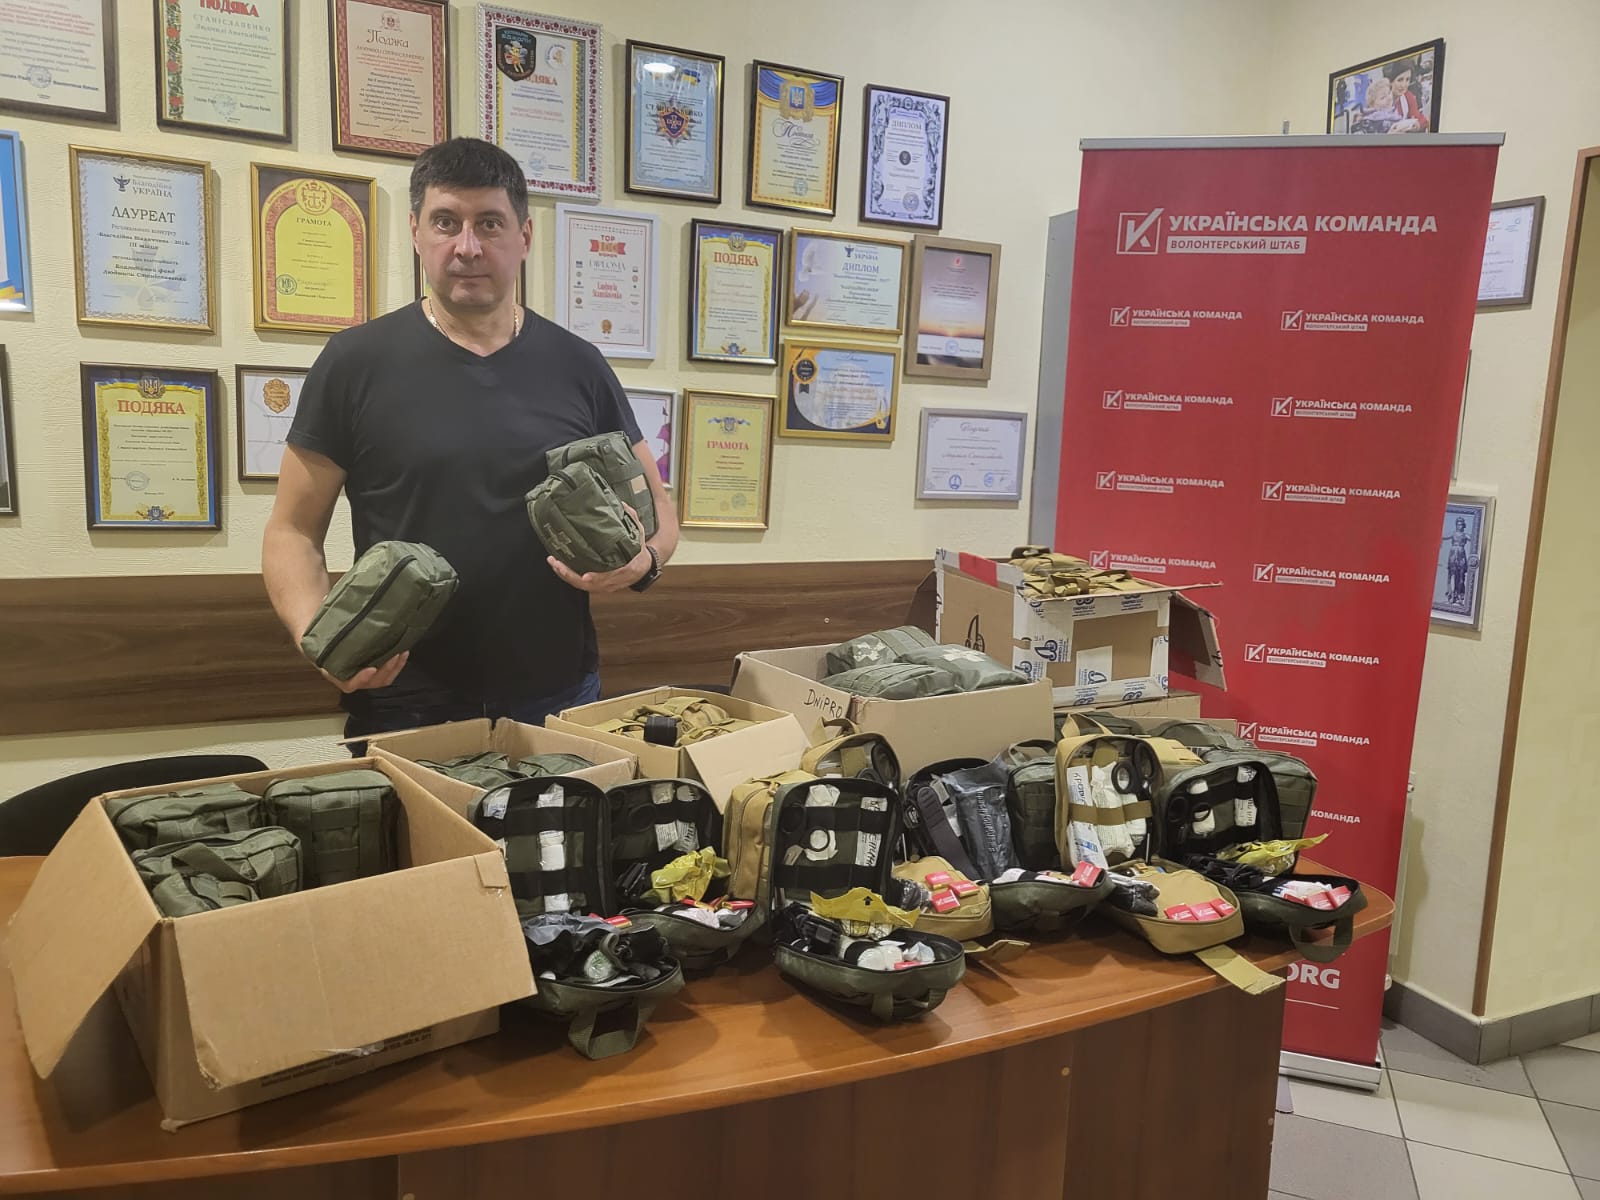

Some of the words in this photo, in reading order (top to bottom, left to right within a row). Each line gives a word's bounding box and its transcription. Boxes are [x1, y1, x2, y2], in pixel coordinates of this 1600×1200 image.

[891, 120, 922, 131] ДИПЛОМ
[132, 187, 173, 198] УКРАЇНА
[111, 206, 176, 224] ЛАУРЕАТ
[296, 217, 332, 227] ГРАМОТА
[1168, 211, 1308, 232] УКРАЇНСЬКА
[1314, 215, 1438, 235] КОМАНДА
[600, 234, 616, 242] TOP
[1170, 239, 1266, 250] ВОЛОНТЕРСЬКИЙ
[1270, 240, 1301, 250] ШТАБ
[714, 252, 759, 266] ПОДЯКА
[842, 262, 880, 274] ДИПЛОМ
[1132, 308, 1190, 318] УКРАЇНСЬКА
[1193, 310, 1242, 320] КОМАНДА
[1306, 312, 1368, 322] УКРАЇНСЬКА
[1371, 314, 1424, 324] КОМАНДА
[1125, 392, 1182, 402] УКРАЇНСЬКА
[1184, 395, 1234, 405] КОМАНДА
[117, 400, 186, 416] ПОДЯКА
[1295, 399, 1358, 410] УКРАЇНСЬКА
[1360, 402, 1412, 412] КОМАНДА
[707, 440, 749, 451] ГРАМОТА
[1117, 474, 1174, 485] УКРАЇНСЬКА
[1176, 478, 1224, 488] КОМАНДА
[1286, 484, 1346, 495] УКРАЇНСЬКА
[1348, 488, 1400, 499] КОМАНДА
[1110, 554, 1167, 565] УКРАЇНСЬКА
[1168, 558, 1216, 569] КОМАНДА
[1276, 566, 1336, 578] УКРАЇНСЬКА
[1338, 572, 1390, 583] КОМАНДА
[1268, 647, 1327, 660] УКРАЇНСЬКА
[1329, 653, 1380, 666] КОМАНДА
[1259, 726, 1318, 738] УКРАЇНСЬКА
[1320, 732, 1370, 746] КОМАНДА
[1311, 809, 1361, 824] КОМАНДА
